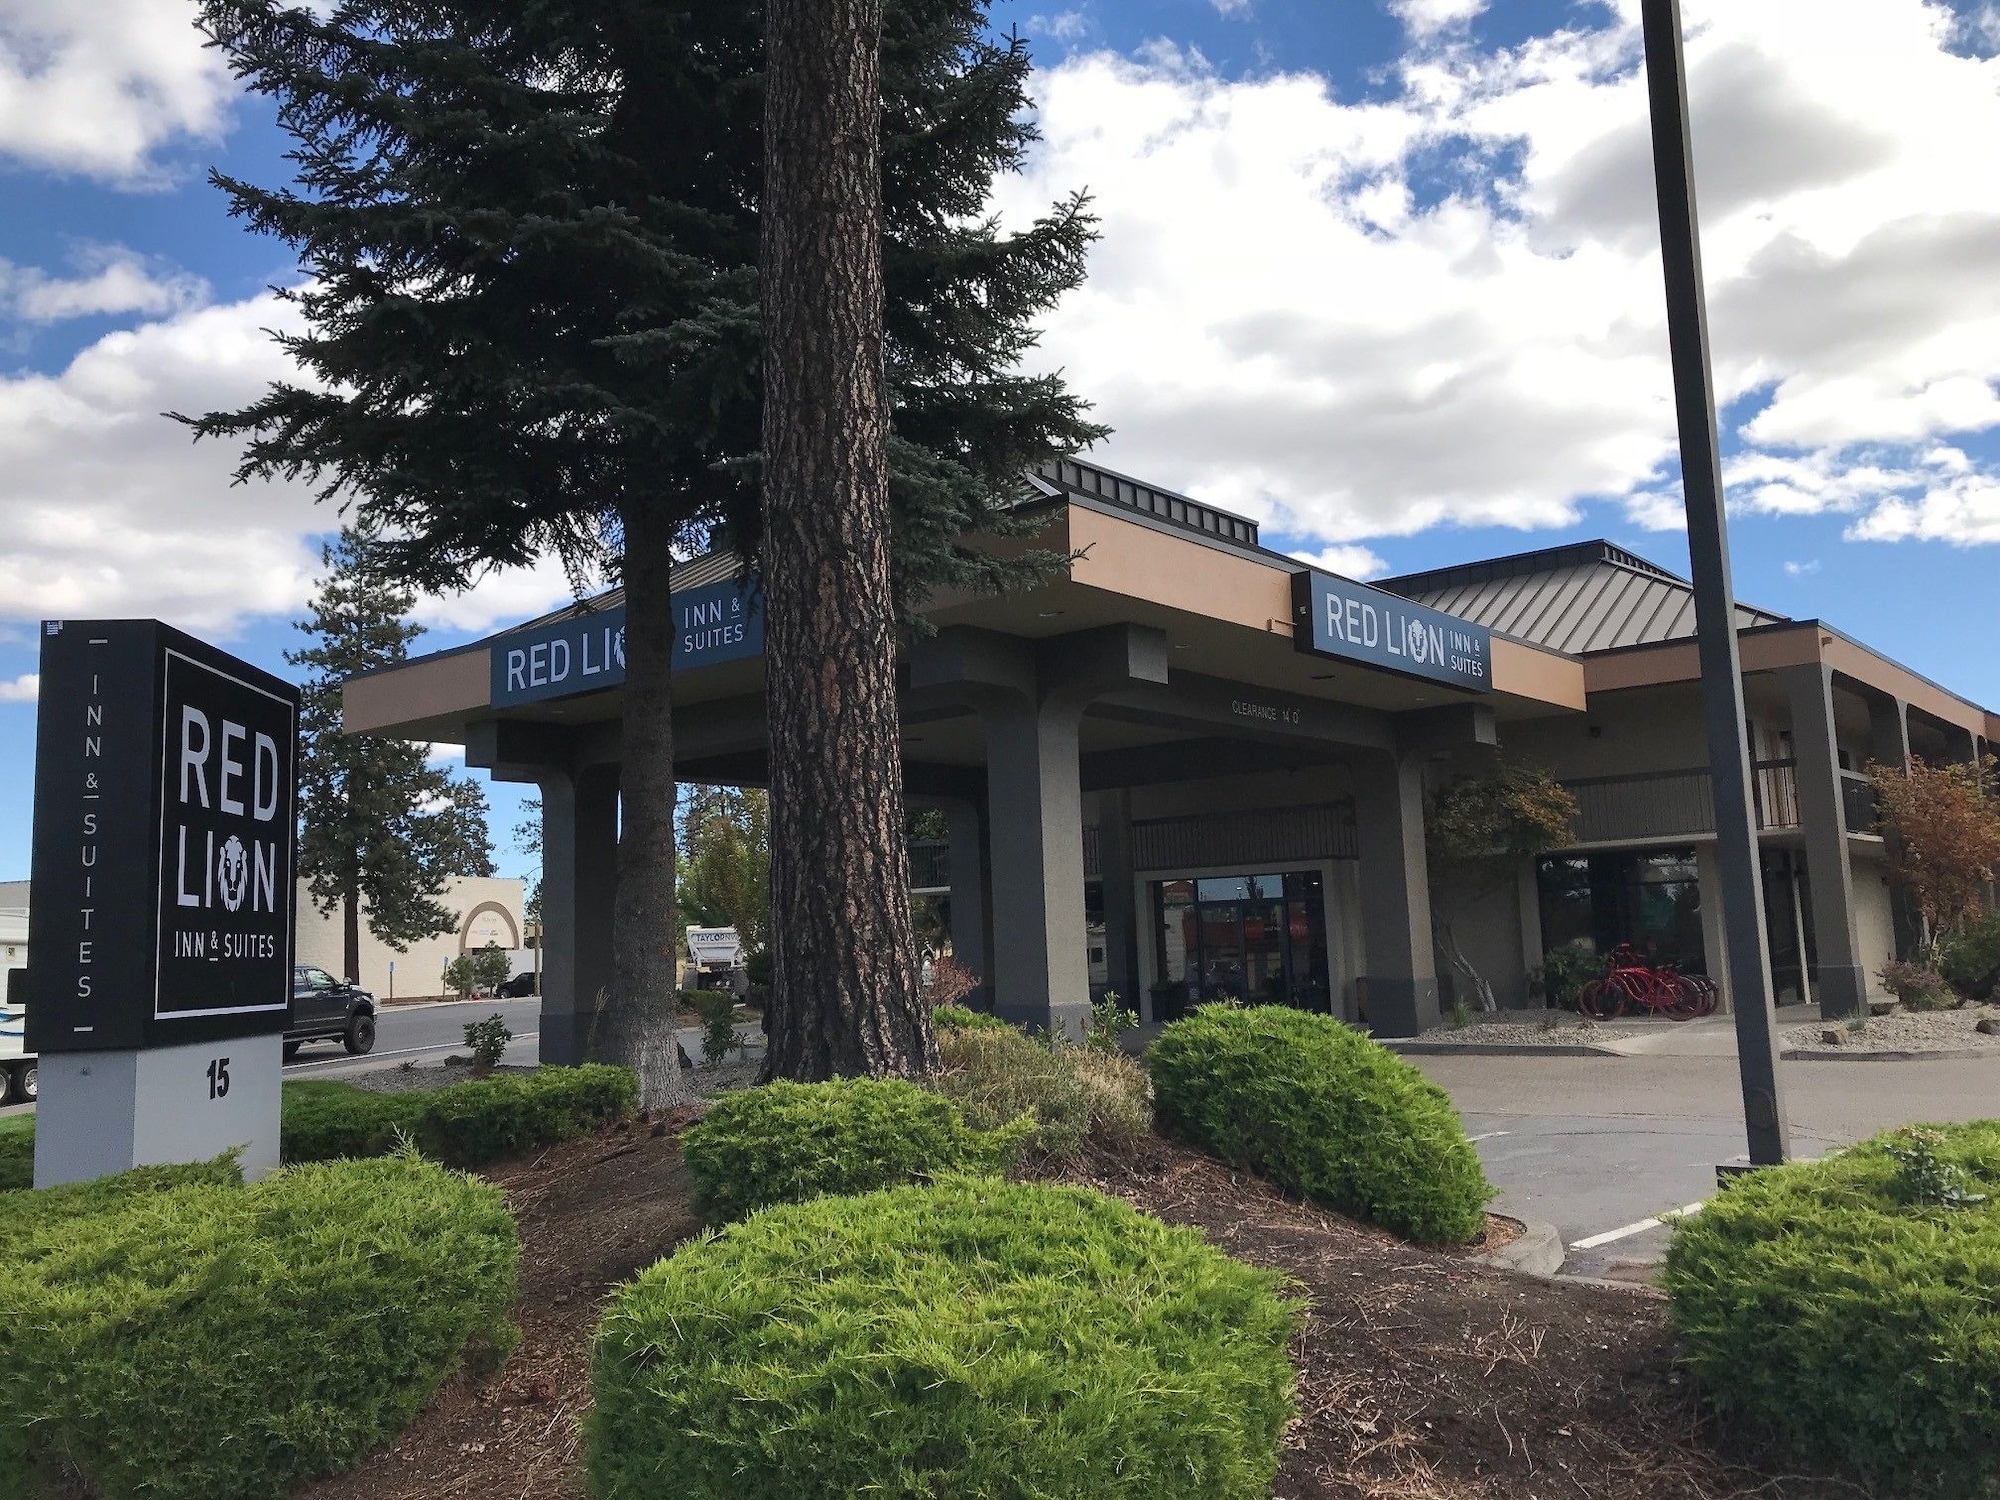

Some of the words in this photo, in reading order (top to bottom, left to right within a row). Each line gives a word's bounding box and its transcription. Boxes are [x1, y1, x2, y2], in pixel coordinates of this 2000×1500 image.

[685, 599, 722, 629] INN
[731, 597, 740, 619] &
[1326, 592, 1379, 648] RED
[1385, 610, 1445, 667] LION
[684, 623, 744, 652] SUITES
[1450, 630, 1471, 654] INN
[1474, 639, 1480, 657] &
[507, 639, 571, 692] RED
[582, 625, 626, 676] LI
[1450, 654, 1483, 678] SUITES
[85, 674, 102, 757] INN
[1231, 699, 1277, 721] CLEARANCE
[179, 704, 279, 822] RED
[83, 772, 99, 799] &
[177, 824, 276, 913] LION
[77, 813, 97, 998] SUITES
[174, 930, 205, 958] INN
[209, 930, 219, 961] &
[224, 932, 274, 958] SUITES
[207, 1058, 230, 1100] 15
